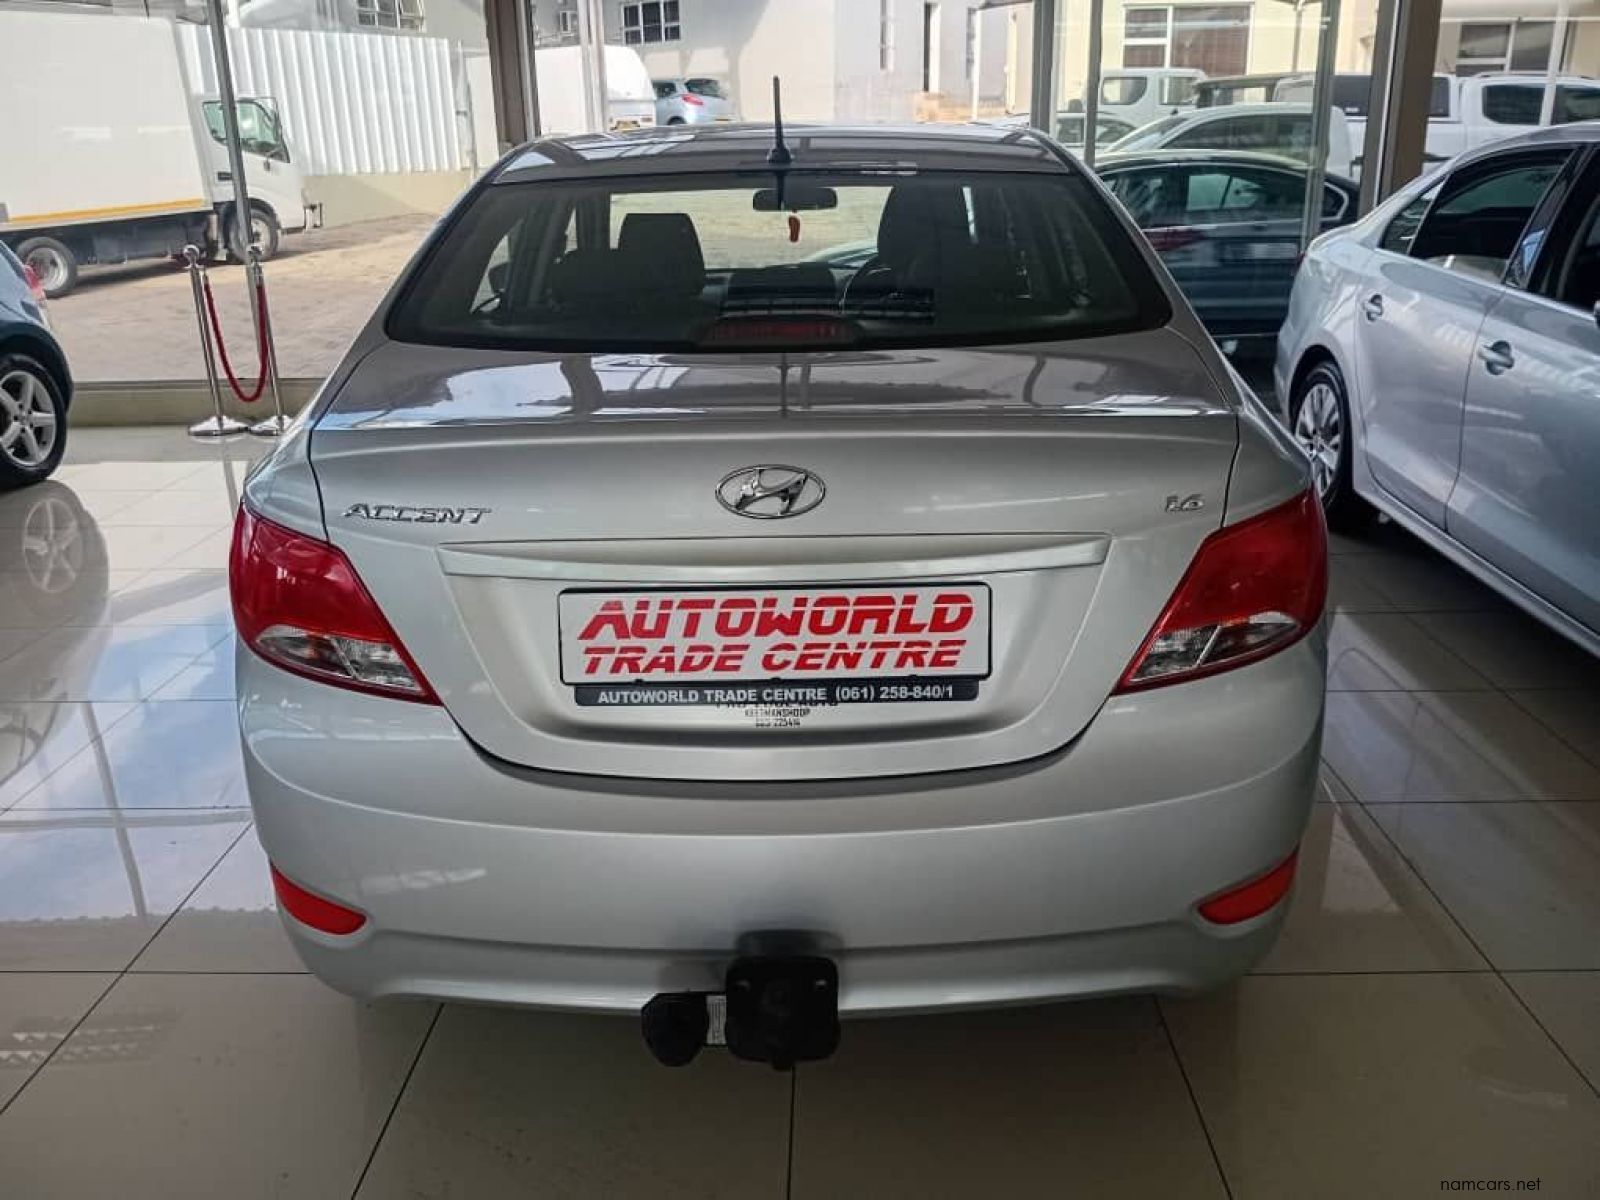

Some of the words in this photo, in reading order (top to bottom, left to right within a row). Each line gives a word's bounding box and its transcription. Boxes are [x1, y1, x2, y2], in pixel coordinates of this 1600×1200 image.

[343, 503, 492, 524] ACCENT
[1165, 494, 1204, 512] 1.6
[578, 594, 973, 641] AUTOWORLD
[583, 644, 751, 674] TRADE
[761, 639, 967, 672] CENTRE
[598, 689, 699, 704] AUTOWORLD
[704, 688, 757, 702] TRADE
[763, 687, 827, 702] CENTRE
[835, 685, 875, 701] (061)
[879, 684, 953, 699] 258-840/1
